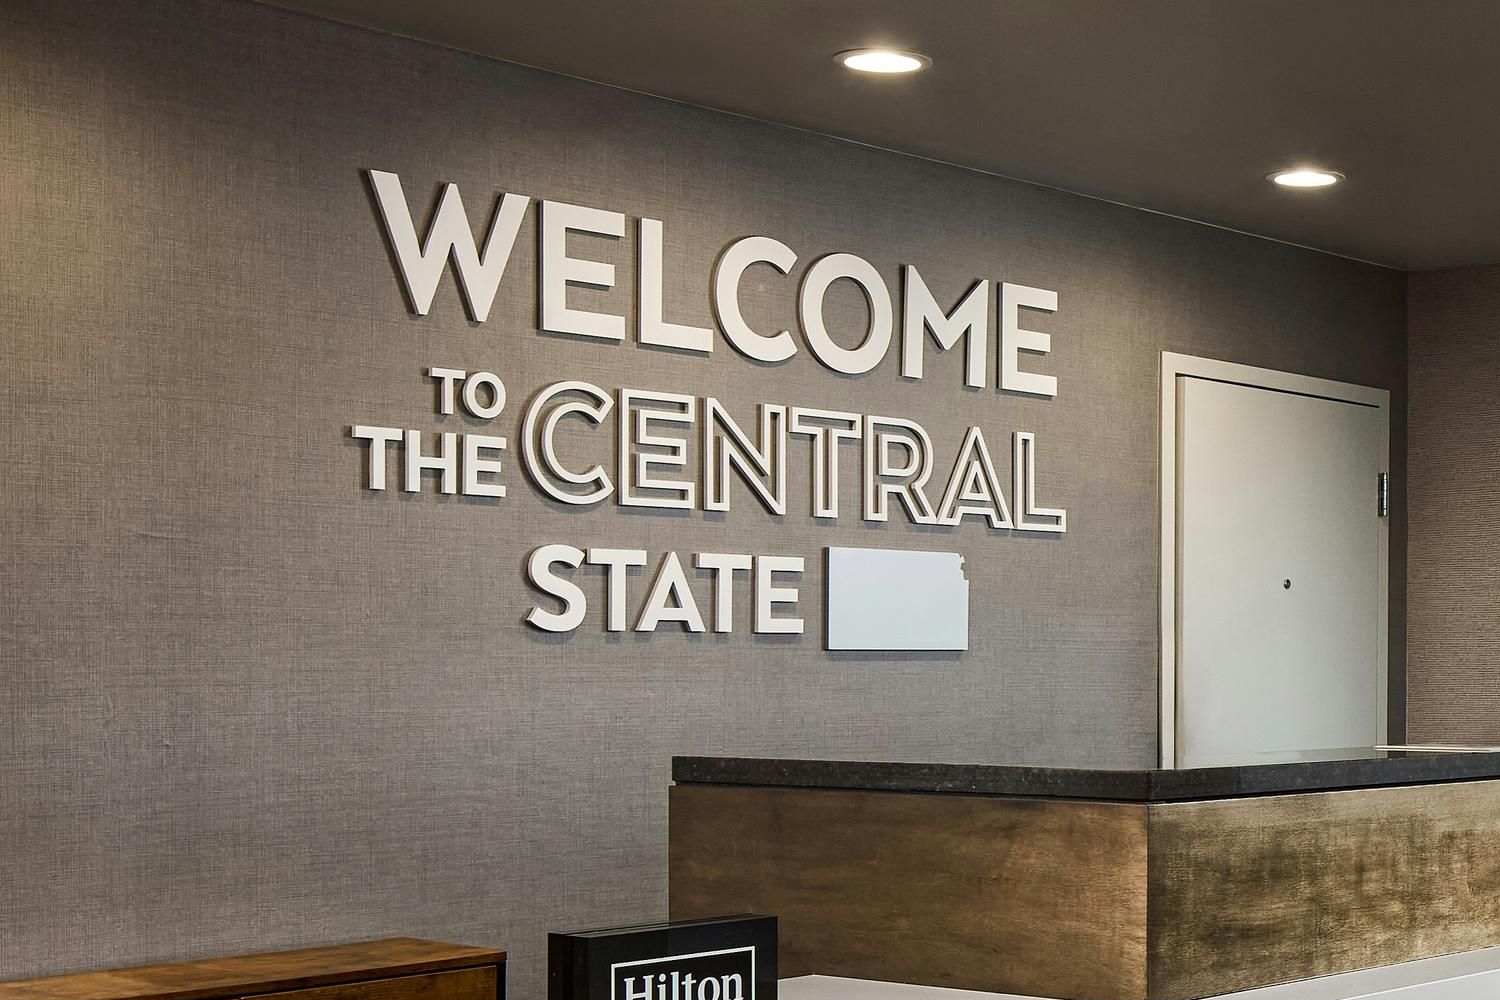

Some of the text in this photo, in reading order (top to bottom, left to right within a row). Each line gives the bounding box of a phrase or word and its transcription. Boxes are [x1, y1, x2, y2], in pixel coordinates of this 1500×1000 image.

[366, 168, 1059, 398] WELCOME
[429, 366, 507, 420] TO
[351, 379, 1067, 534] THE CENTRAL
[527, 543, 805, 635] STATE
